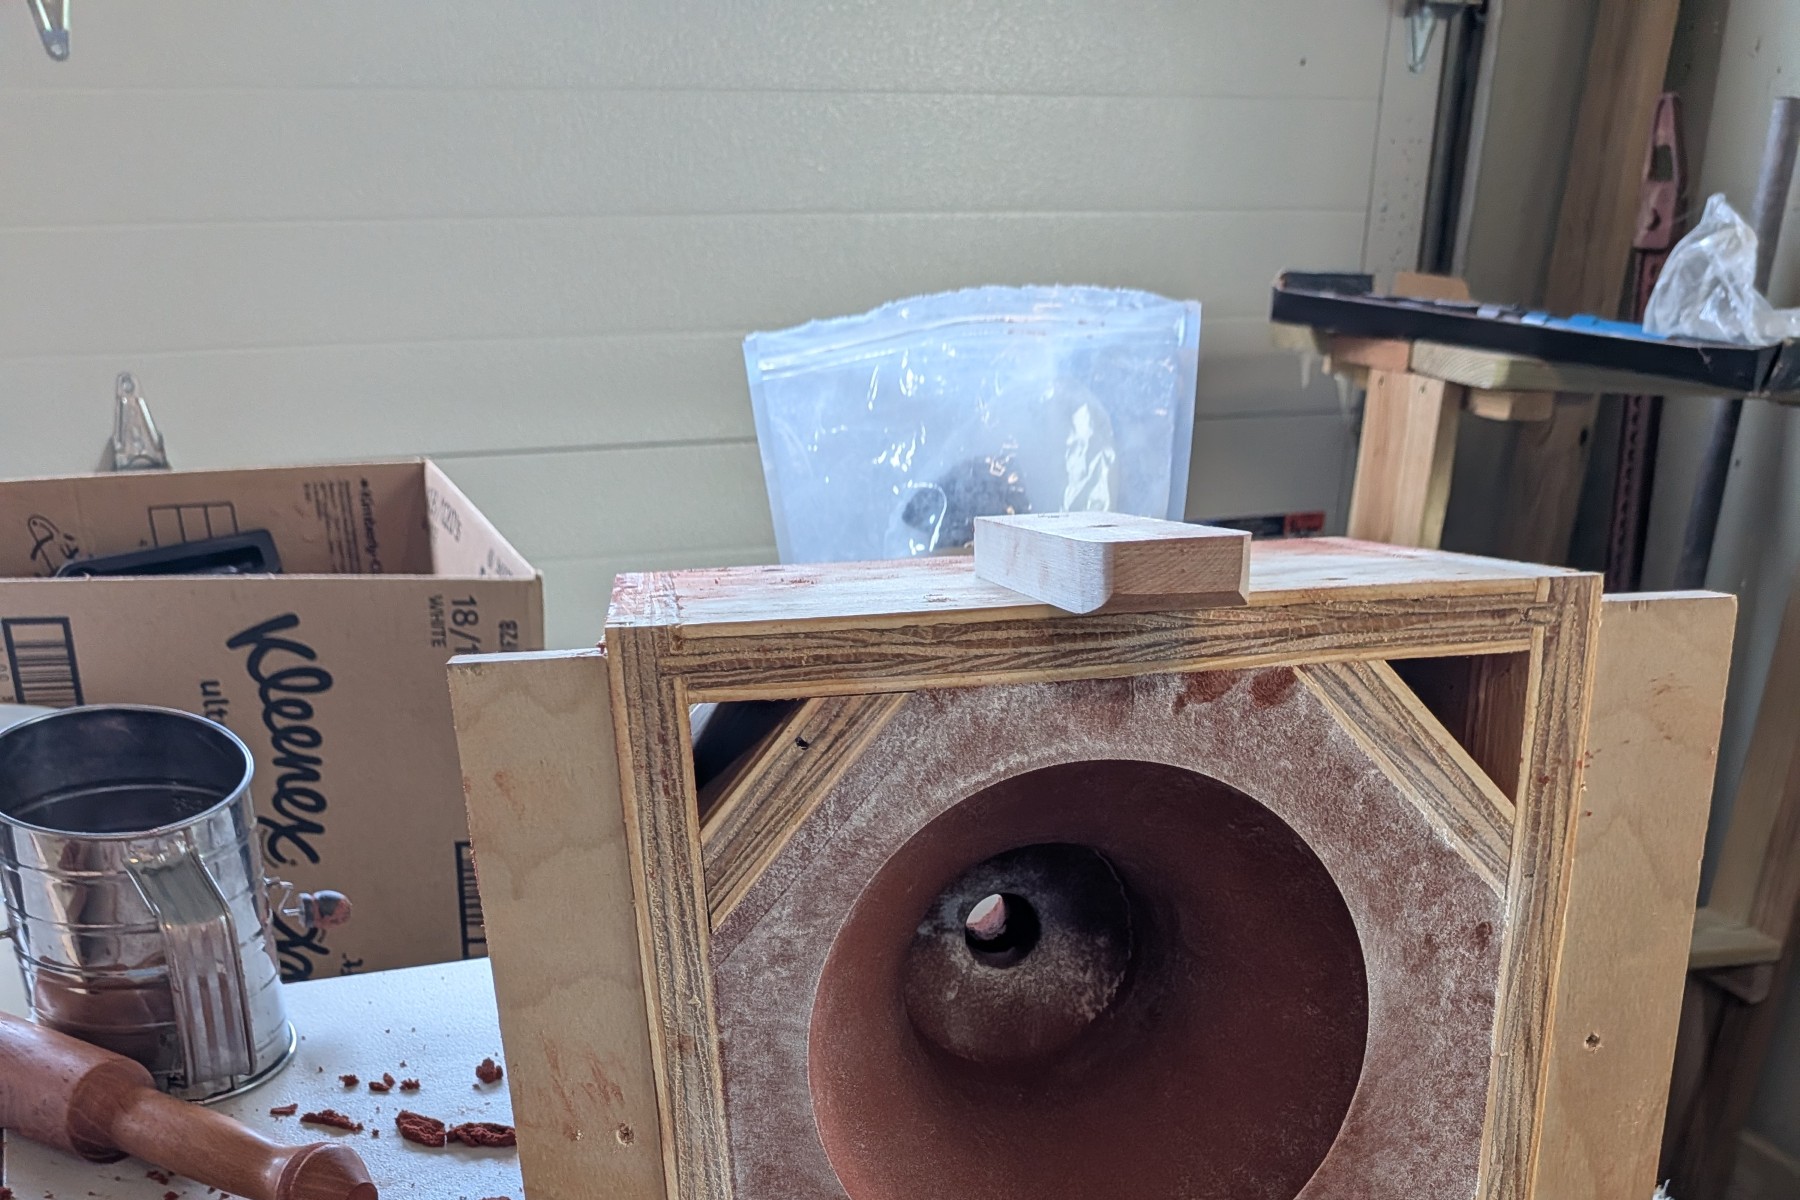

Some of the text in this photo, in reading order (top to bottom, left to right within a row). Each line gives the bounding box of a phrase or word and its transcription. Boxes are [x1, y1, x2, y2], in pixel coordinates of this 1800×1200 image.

[428, 594, 447, 648] WHITE
[448, 594, 481, 654] 18/1
[201, 680, 230, 724] ult
[226, 613, 333, 864] Kleenex
